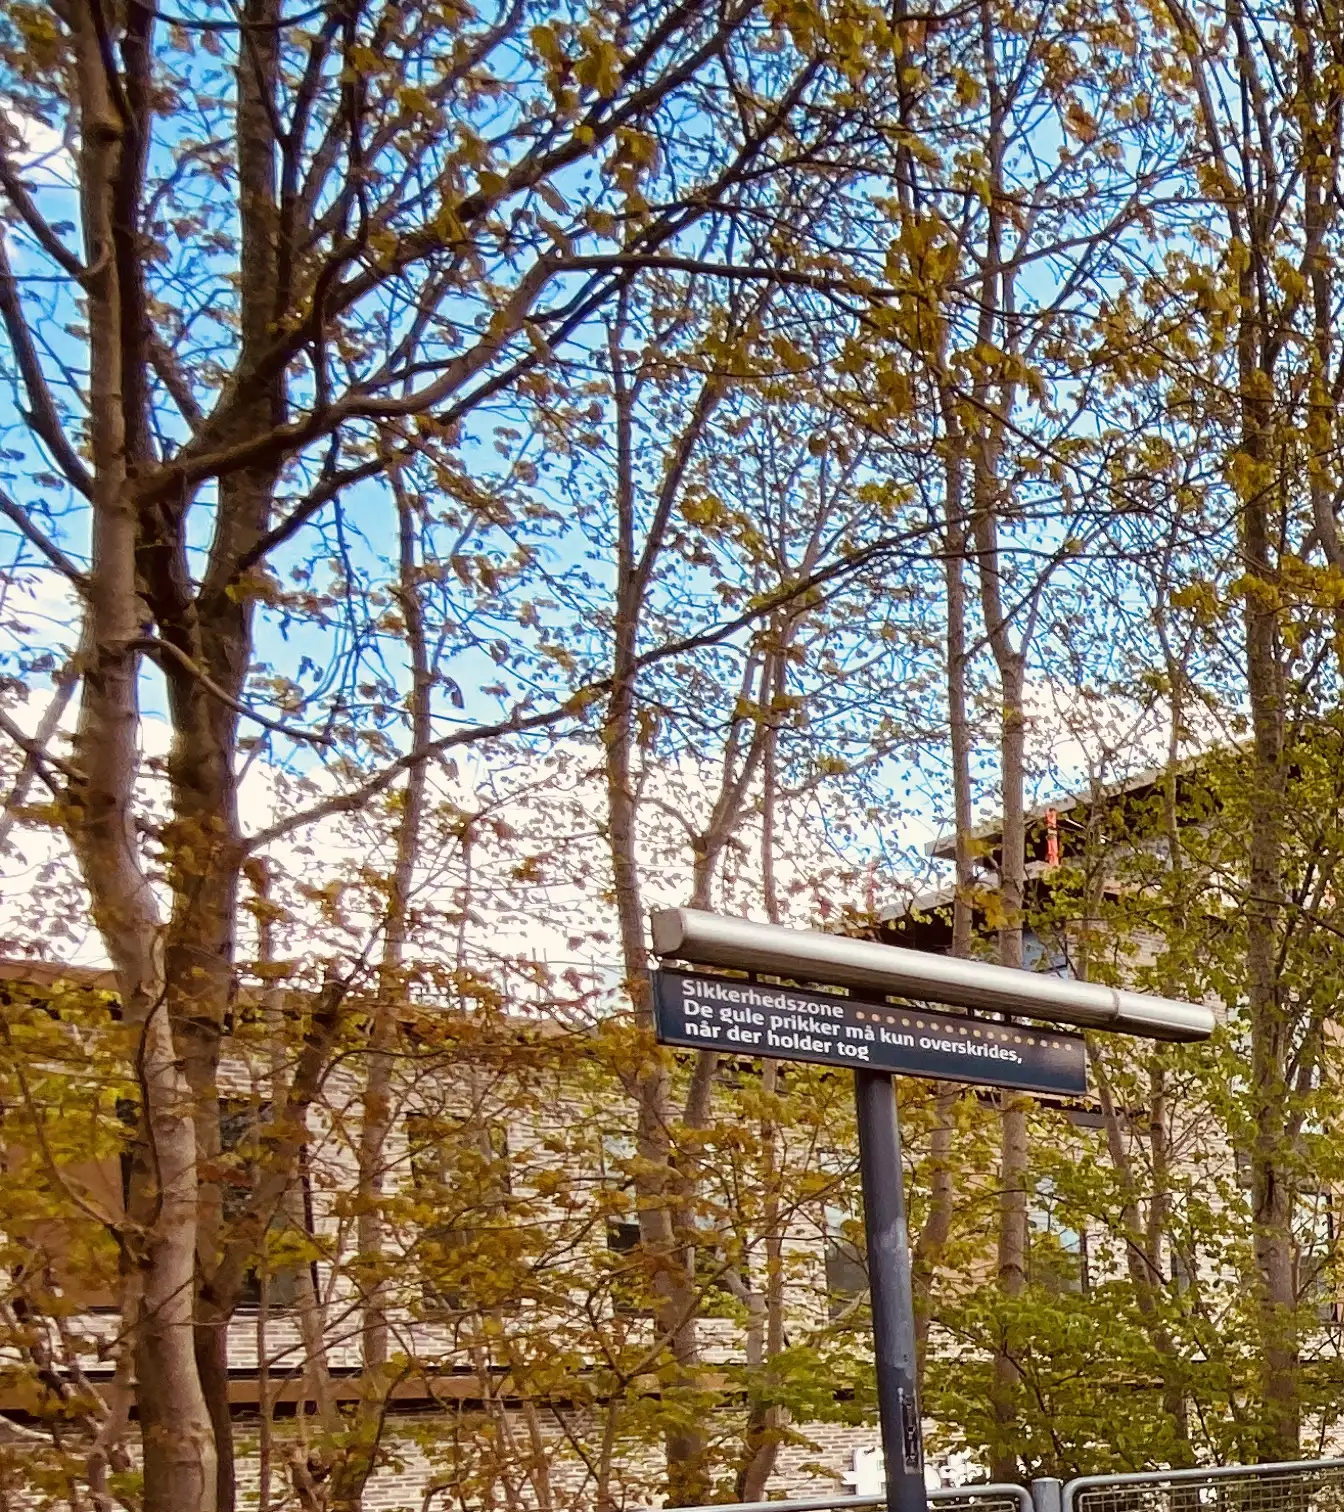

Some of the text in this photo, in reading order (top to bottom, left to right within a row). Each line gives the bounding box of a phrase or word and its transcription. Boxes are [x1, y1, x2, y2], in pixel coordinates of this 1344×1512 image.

[681, 979, 844, 1018] Sikkerhedszone
[683, 999, 1023, 1064] De gule prikker må kun overskrides,
[684, 1020, 870, 1062] når der holder tog
